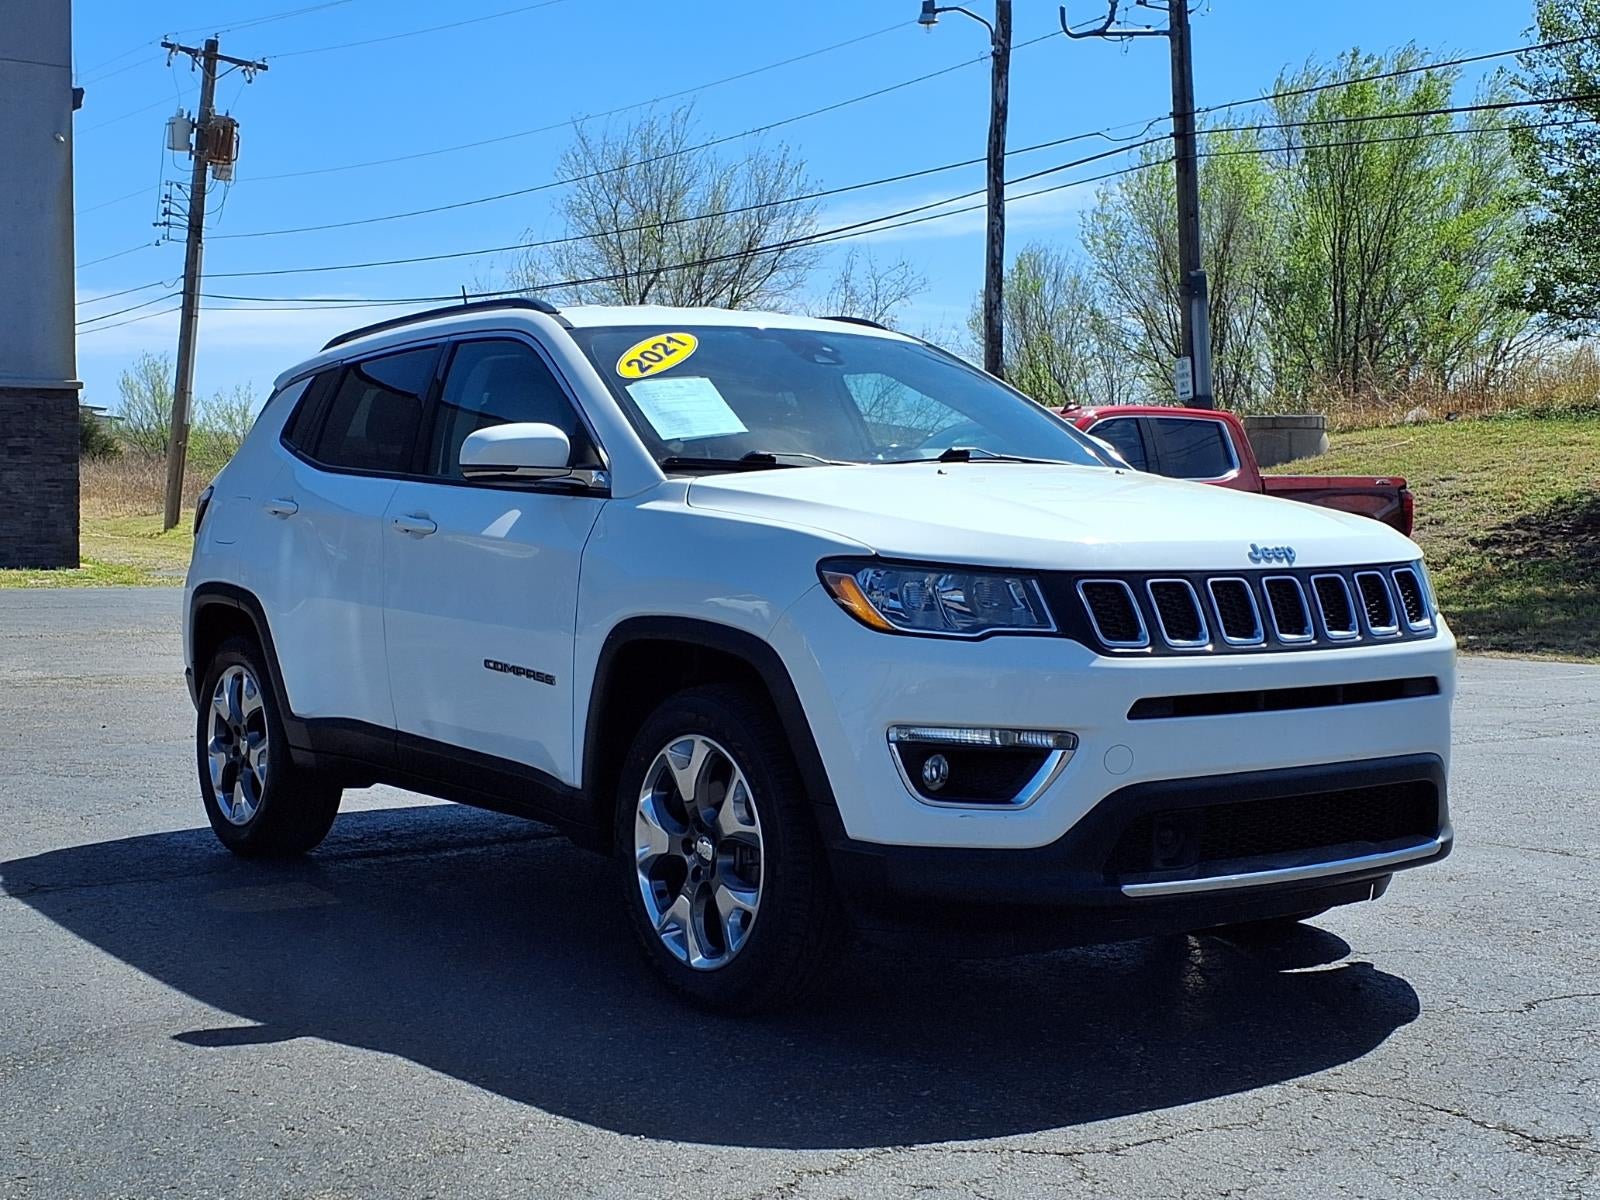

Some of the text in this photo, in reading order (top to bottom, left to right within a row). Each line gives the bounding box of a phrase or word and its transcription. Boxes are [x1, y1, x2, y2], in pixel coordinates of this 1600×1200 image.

[626, 336, 687, 373] 2021
[1248, 543, 1296, 567] Jeep
[484, 659, 556, 686] COMPASS
